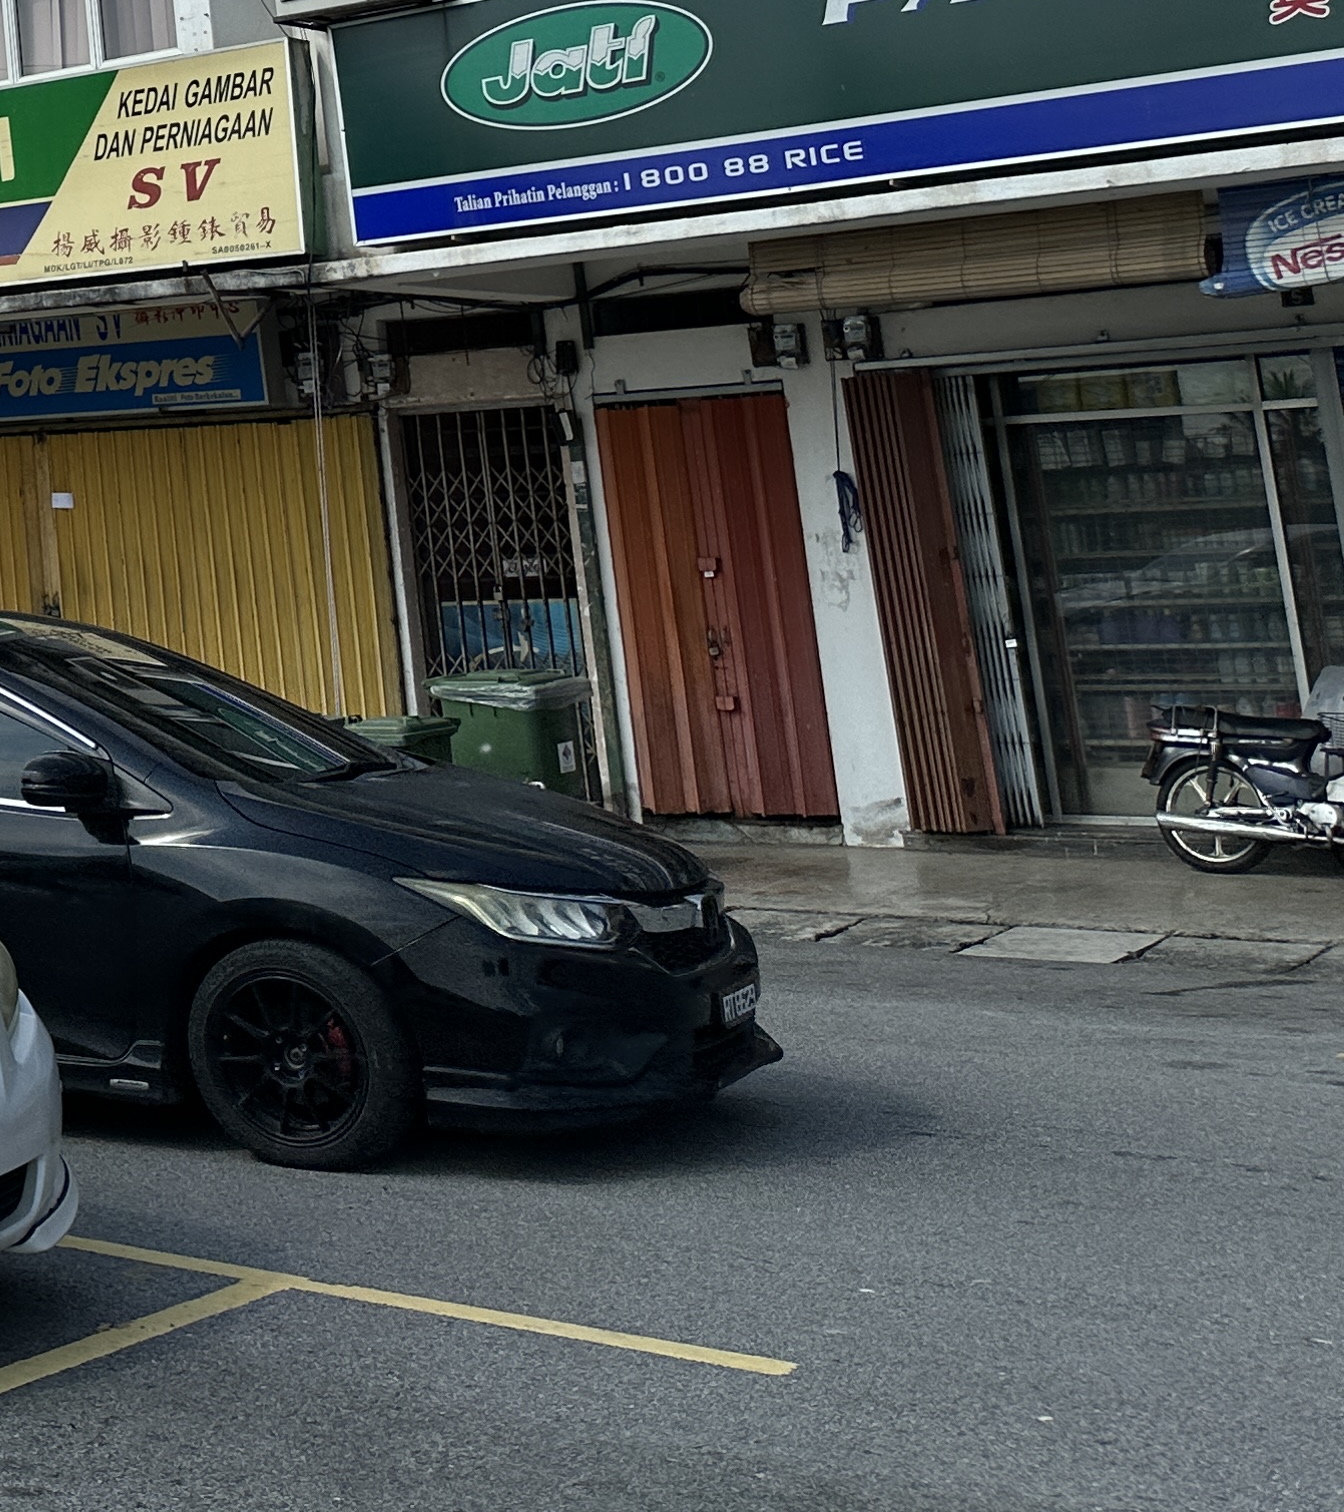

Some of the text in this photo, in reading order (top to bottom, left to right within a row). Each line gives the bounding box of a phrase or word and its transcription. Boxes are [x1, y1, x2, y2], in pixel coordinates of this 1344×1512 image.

[481, 15, 657, 106] Jati
[117, 67, 274, 119] KEDAI GAMBAR
[93, 107, 274, 161] DAN PERNIAGAAN
[454, 194, 492, 213] Talian
[494, 186, 545, 208] Prihatin
[547, 179, 612, 203] Pelanggan
[641, 162, 709, 189] 800
[723, 154, 770, 178] 88
[785, 141, 864, 170] RICE
[1268, 193, 1344, 234] ICE CREA
[1270, 234, 1344, 280] Nes
[75, 353, 214, 395] Ekspres
